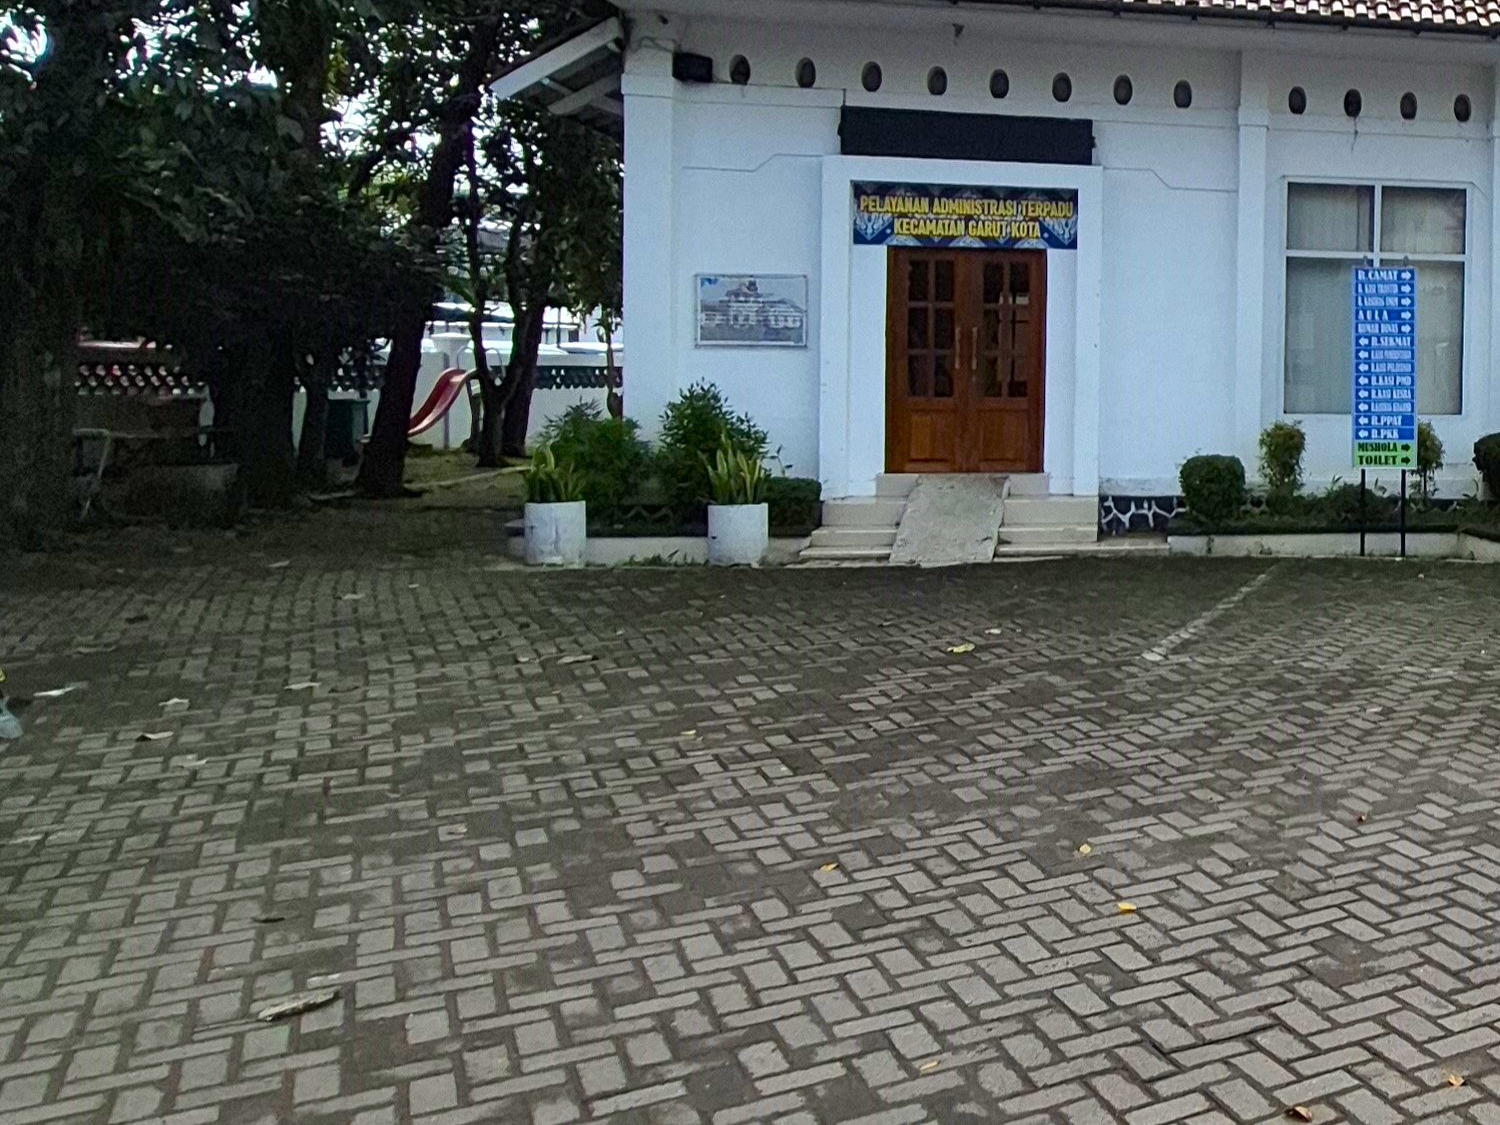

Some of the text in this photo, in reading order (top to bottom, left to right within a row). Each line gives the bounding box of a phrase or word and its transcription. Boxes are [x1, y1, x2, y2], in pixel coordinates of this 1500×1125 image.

[860, 195, 1073, 218] PELAYANAN ADMINISTRASI TERPADU
[894, 218, 1041, 238] KECAMATAN GARUT KOTA
[1358, 442, 1398, 452] MUSHOLA
[1358, 455, 1398, 465] TOILET
